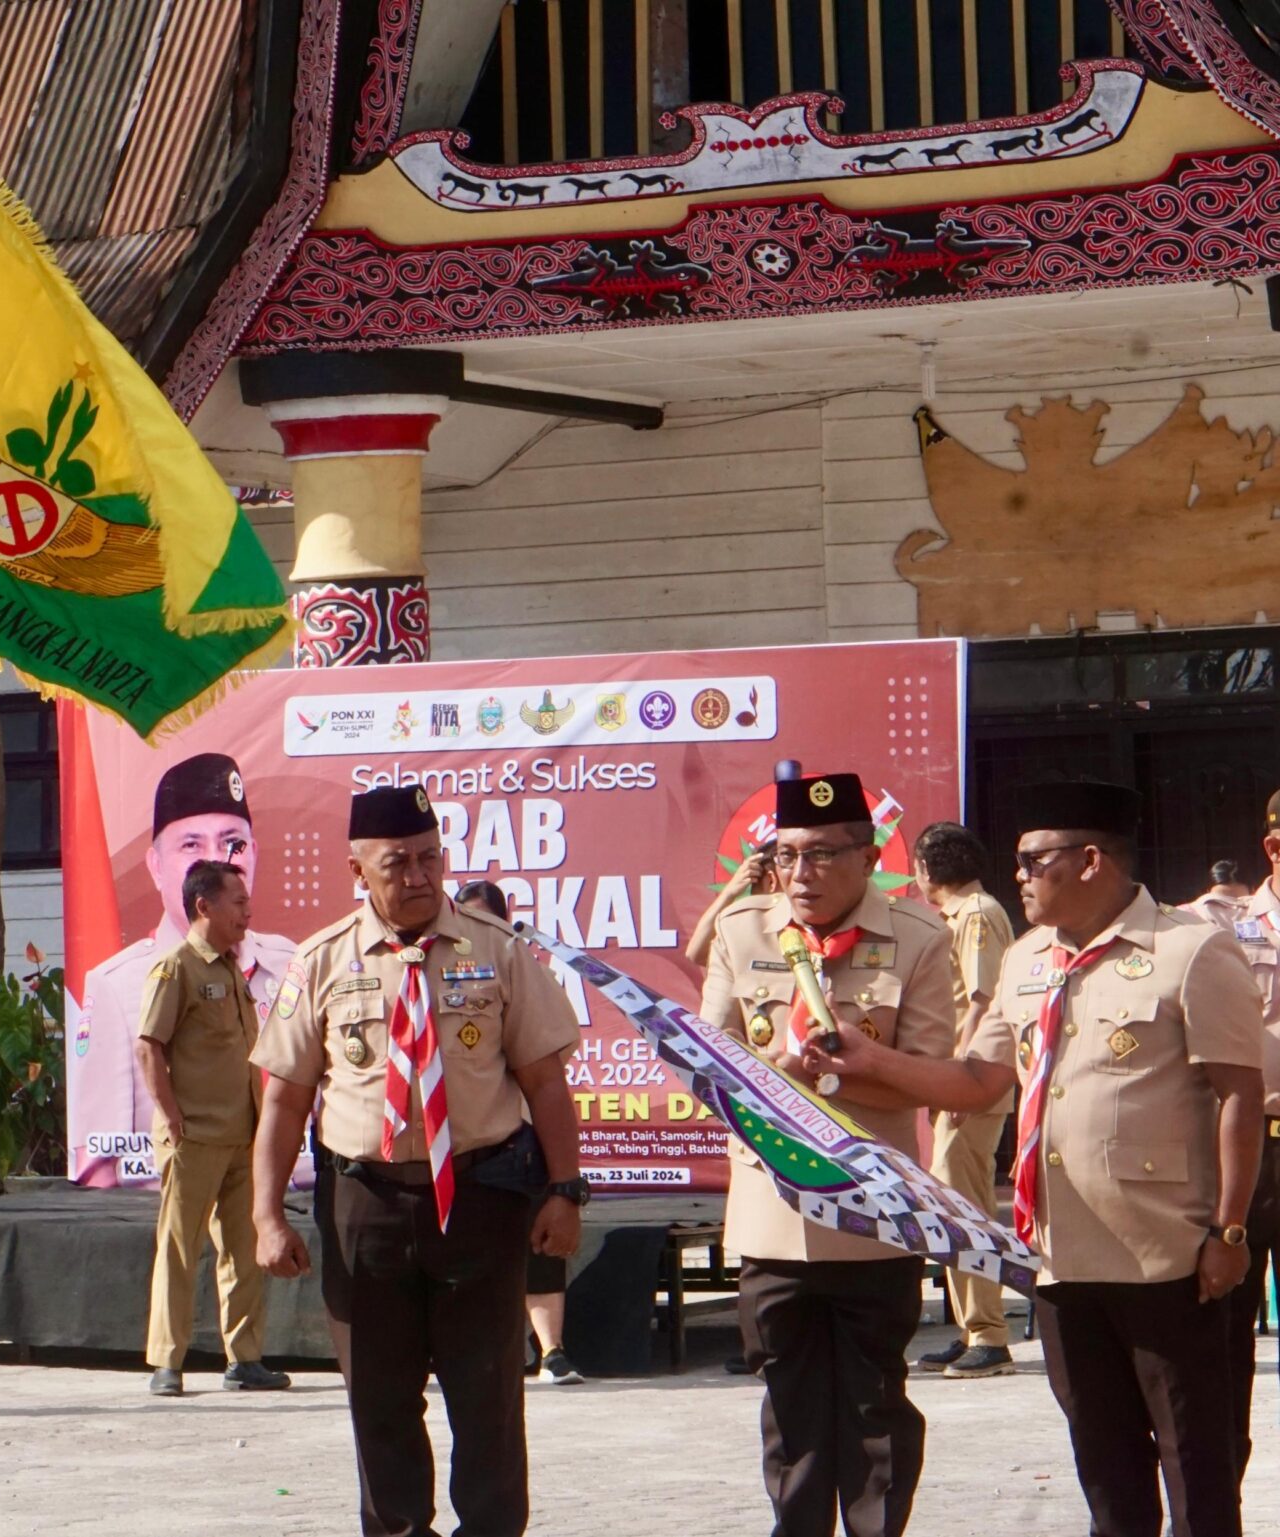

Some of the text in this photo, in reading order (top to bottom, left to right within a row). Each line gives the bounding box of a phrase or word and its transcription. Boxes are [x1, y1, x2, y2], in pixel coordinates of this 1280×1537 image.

[76, 647, 153, 710] NAPZA
[331, 710, 375, 720] PON XXI
[431, 710, 459, 727] KITA
[344, 731, 360, 739] 2024
[351, 755, 657, 795] Selamat & Sukses
[431, 798, 567, 873] RAB
[691, 1017, 752, 1065] UTARA
[600, 1063, 666, 1085] 2024
[574, 1093, 650, 1120] TEN
[746, 1061, 843, 1142] SUMATERA
[592, 1131, 629, 1143] Bharat,
[632, 1130, 658, 1143] Dairi,
[661, 1131, 705, 1143] Samosir,
[580, 1144, 727, 1156] dagai, Tebing Tinggi, Batuba
[124, 1161, 152, 1175] KA.
[610, 1170, 623, 1180] 23
[627, 1169, 649, 1180] Juli
[653, 1170, 683, 1180] 2024
